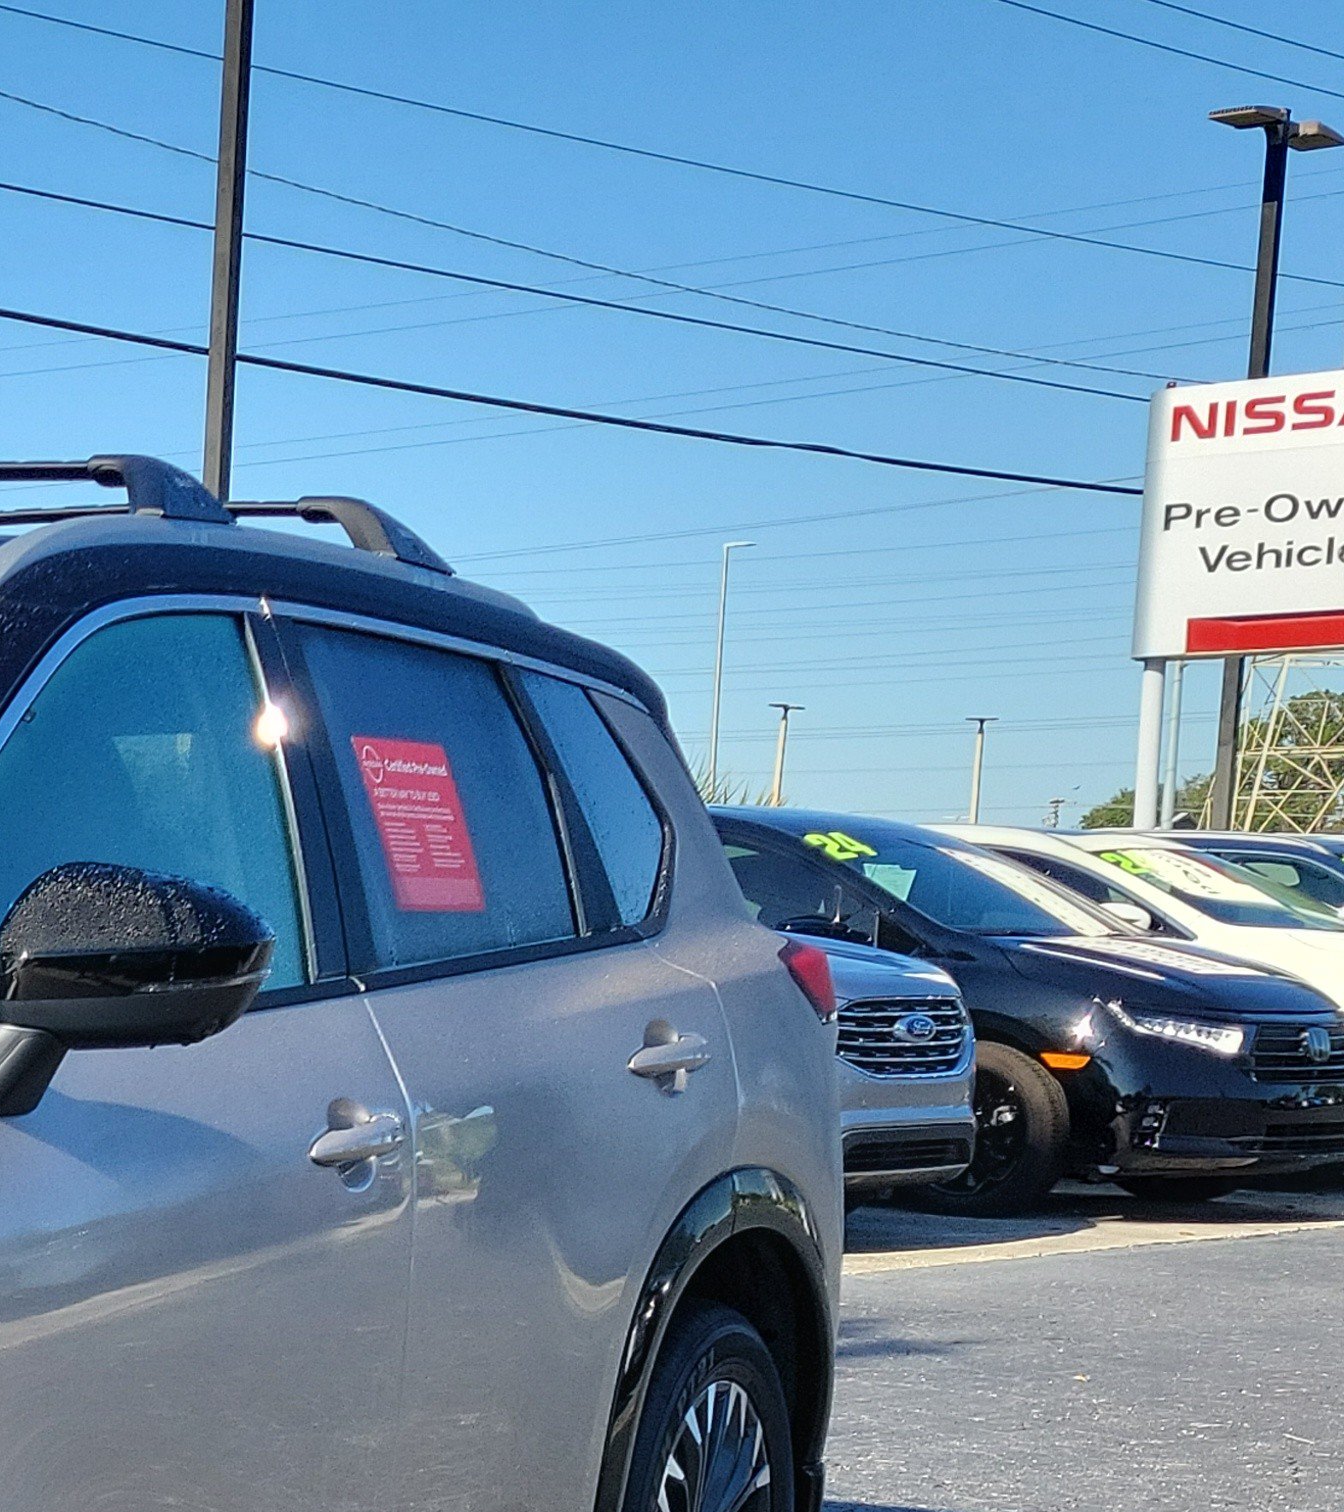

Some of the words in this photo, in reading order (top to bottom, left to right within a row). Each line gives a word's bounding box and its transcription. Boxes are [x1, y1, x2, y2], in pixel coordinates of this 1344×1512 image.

[1171, 390, 1344, 442] NISS
[1199, 537, 1344, 574] Vehicl
[802, 831, 878, 861] 24
